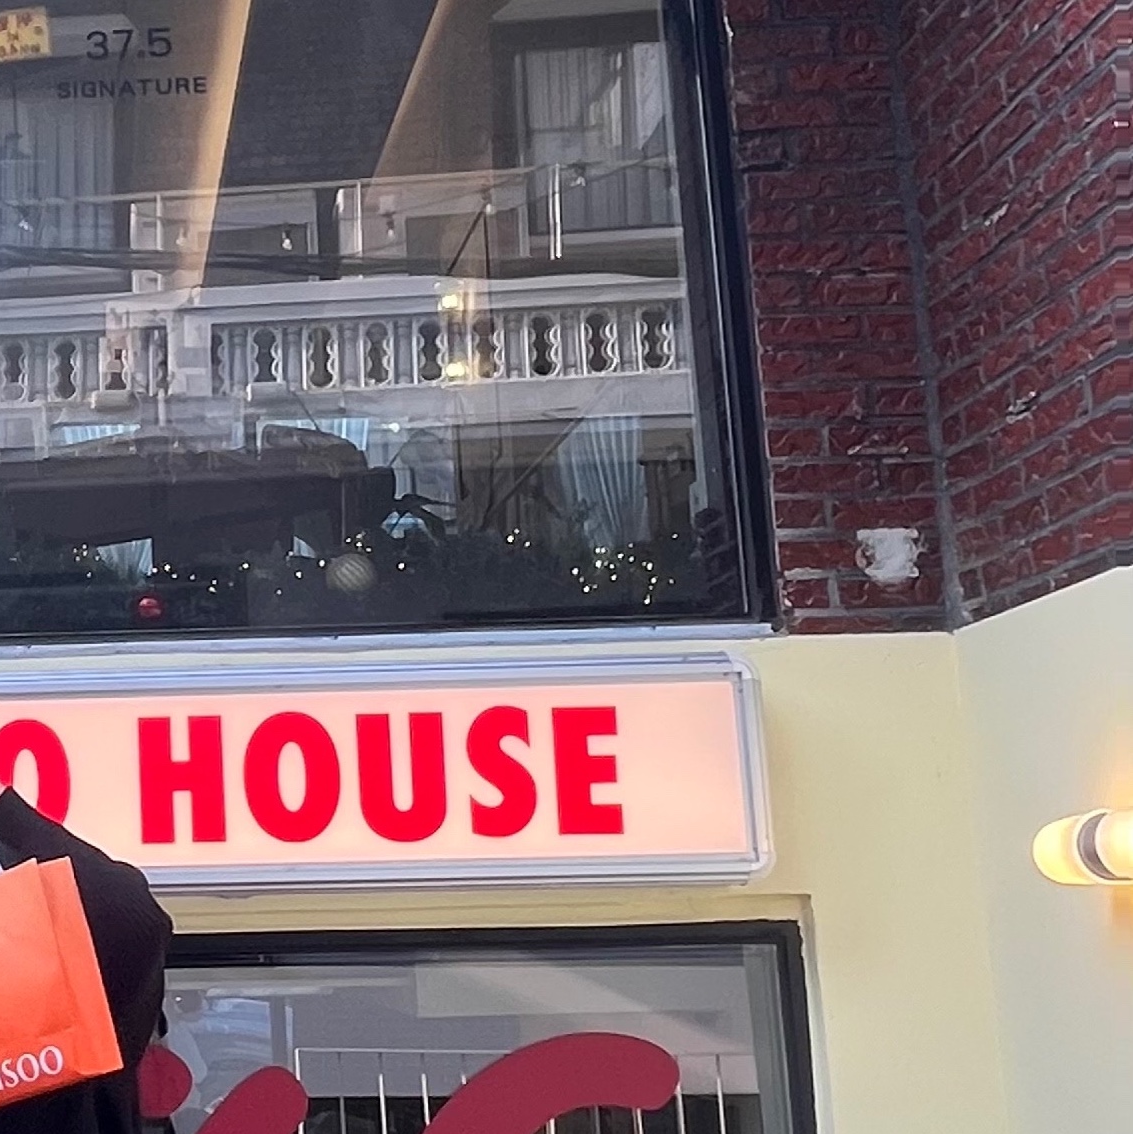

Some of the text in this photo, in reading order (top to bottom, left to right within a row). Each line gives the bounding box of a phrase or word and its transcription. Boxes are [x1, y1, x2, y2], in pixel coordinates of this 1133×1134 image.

[86, 28, 173, 61] 37.5
[57, 76, 208, 99] SIGNATURE
[137, 706, 624, 844] HOUSE
